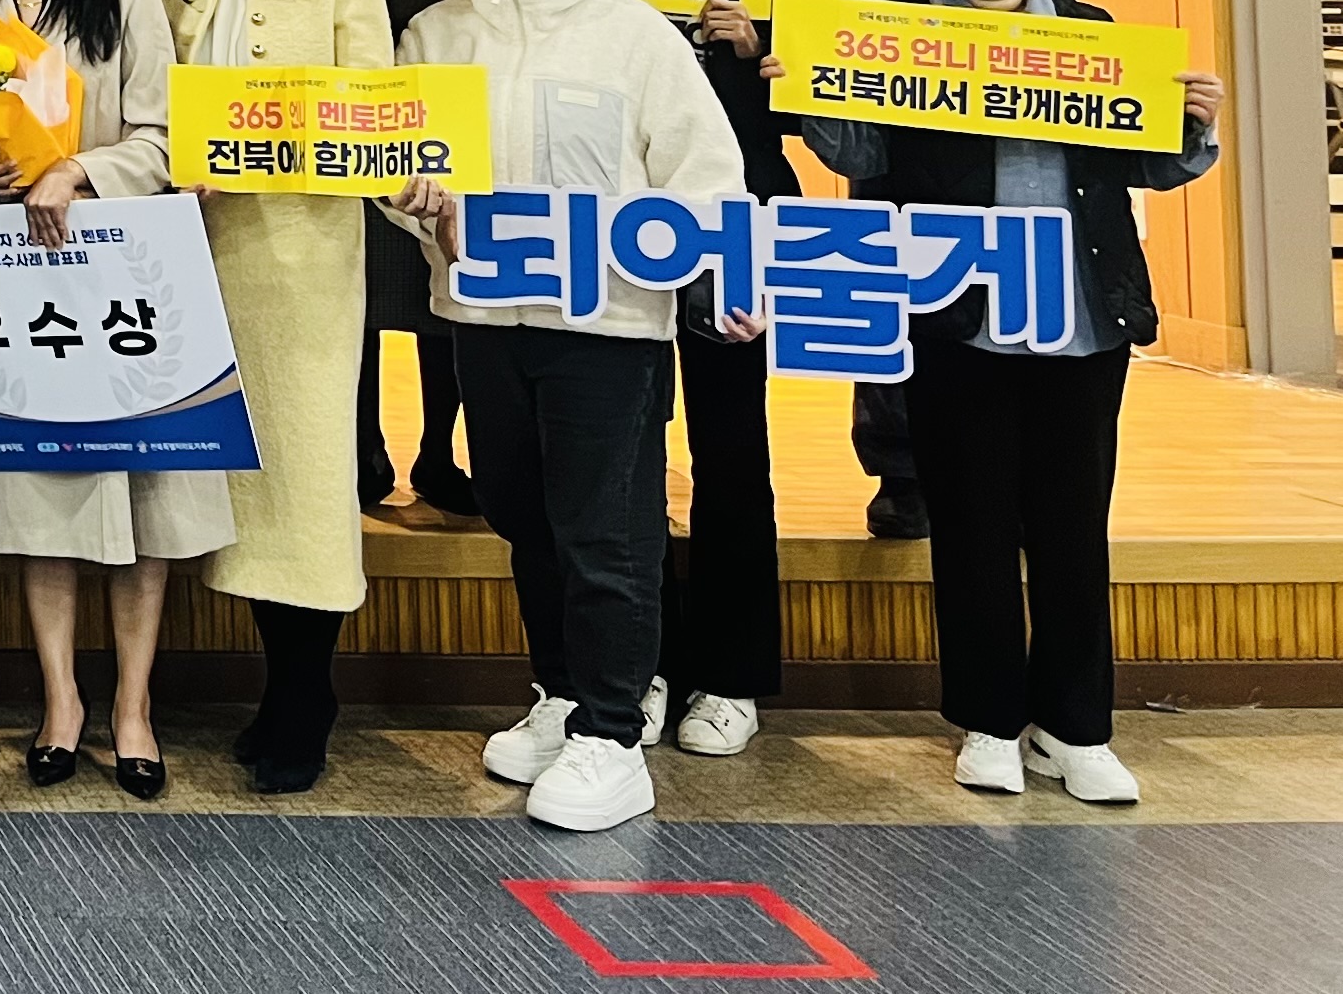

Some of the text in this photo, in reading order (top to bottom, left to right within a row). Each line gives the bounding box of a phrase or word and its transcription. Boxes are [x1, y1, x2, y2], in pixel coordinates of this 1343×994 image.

[834, 31, 1122, 85] 365 언니 멘토단과
[229, 102, 283, 129] 365
[319, 101, 425, 132] 멘토단과
[812, 66, 1143, 131] 전북에서 함께해요
[314, 140, 452, 177] 함께해요
[81, 228, 124, 243] 멘토단
[46, 251, 88, 266] 발표회
[458, 191, 1063, 375] 되어줄게
